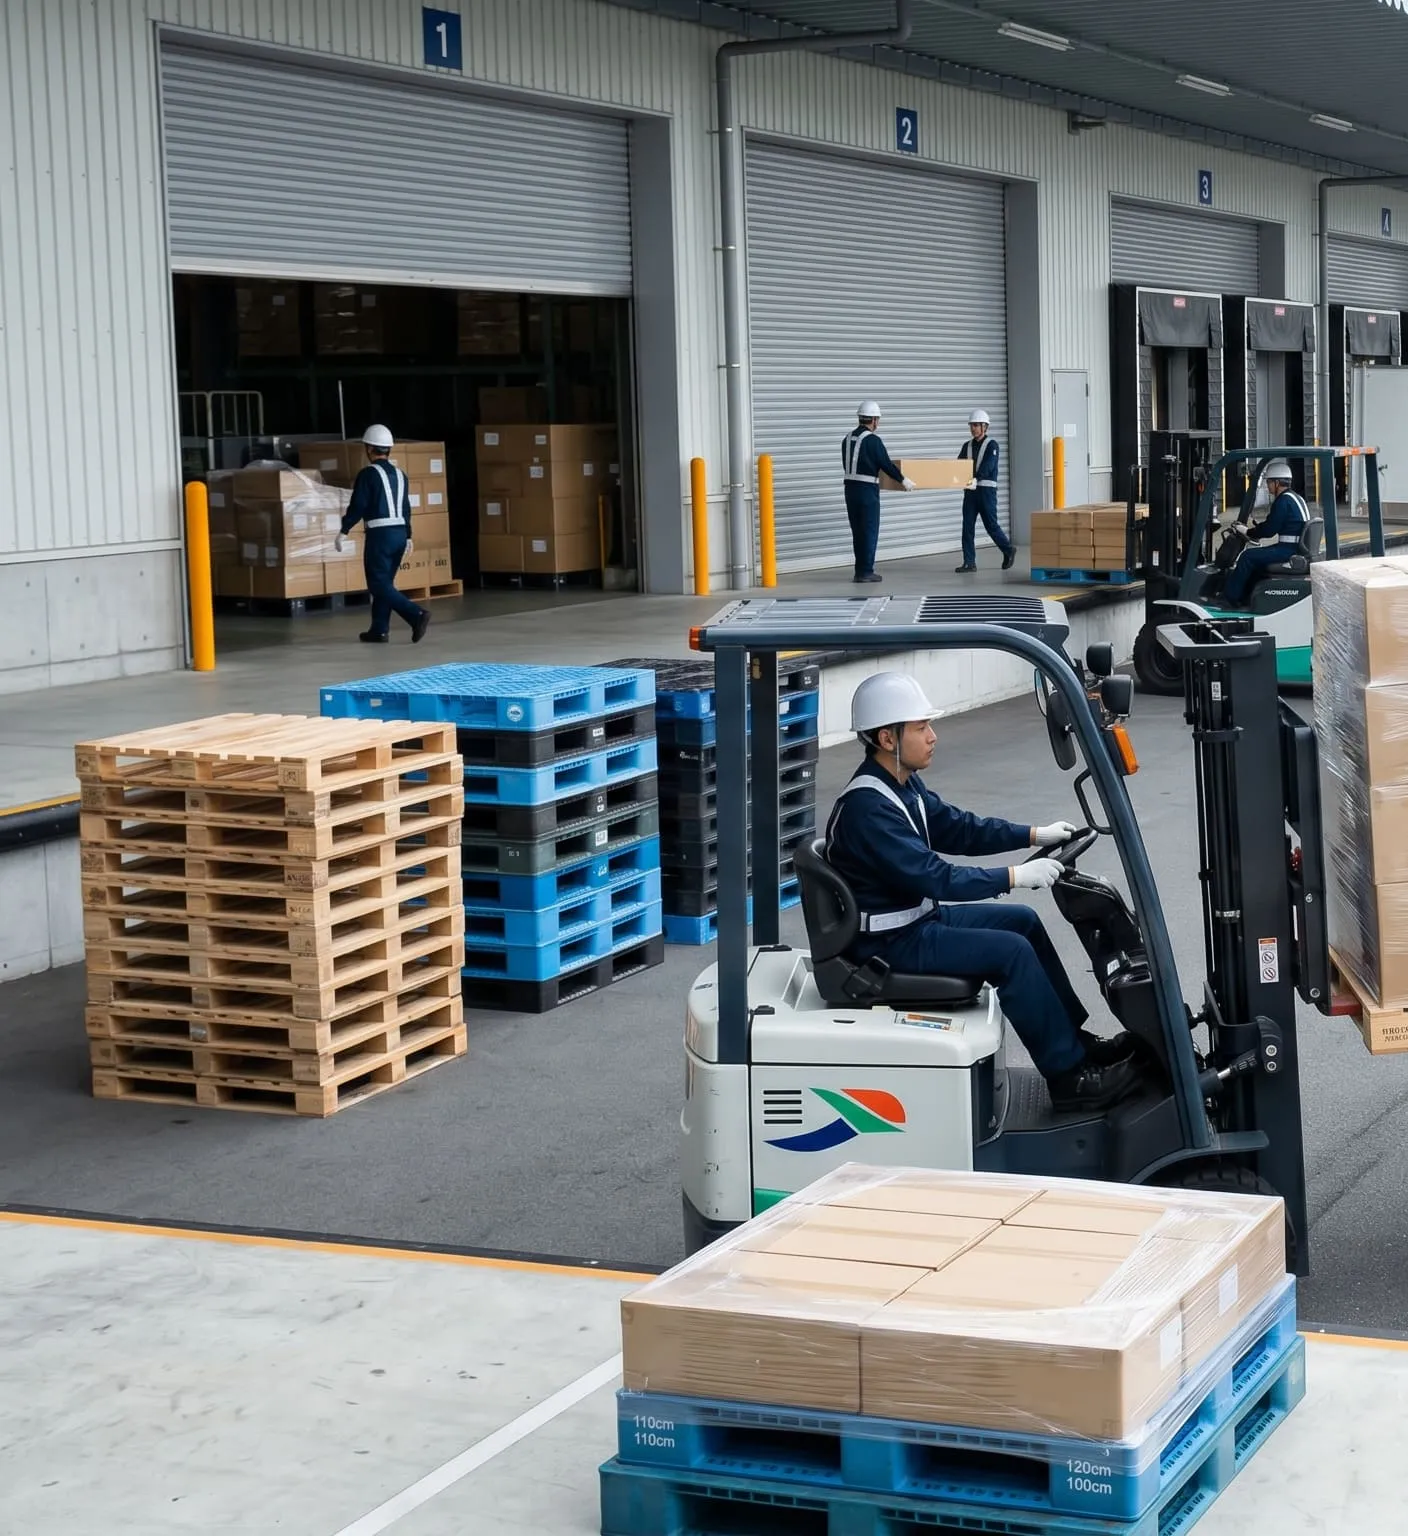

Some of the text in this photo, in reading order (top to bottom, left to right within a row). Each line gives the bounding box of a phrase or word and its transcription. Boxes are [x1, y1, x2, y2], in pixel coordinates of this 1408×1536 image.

[436, 22, 447, 58] 1
[902, 117, 913, 145] 2
[1202, 175, 1209, 199] 3
[633, 1415, 674, 1431] 110cm
[634, 1432, 675, 1449] 110cm
[1066, 1459, 1112, 1478] 120cm
[1066, 1476, 1112, 1495] 100cm
